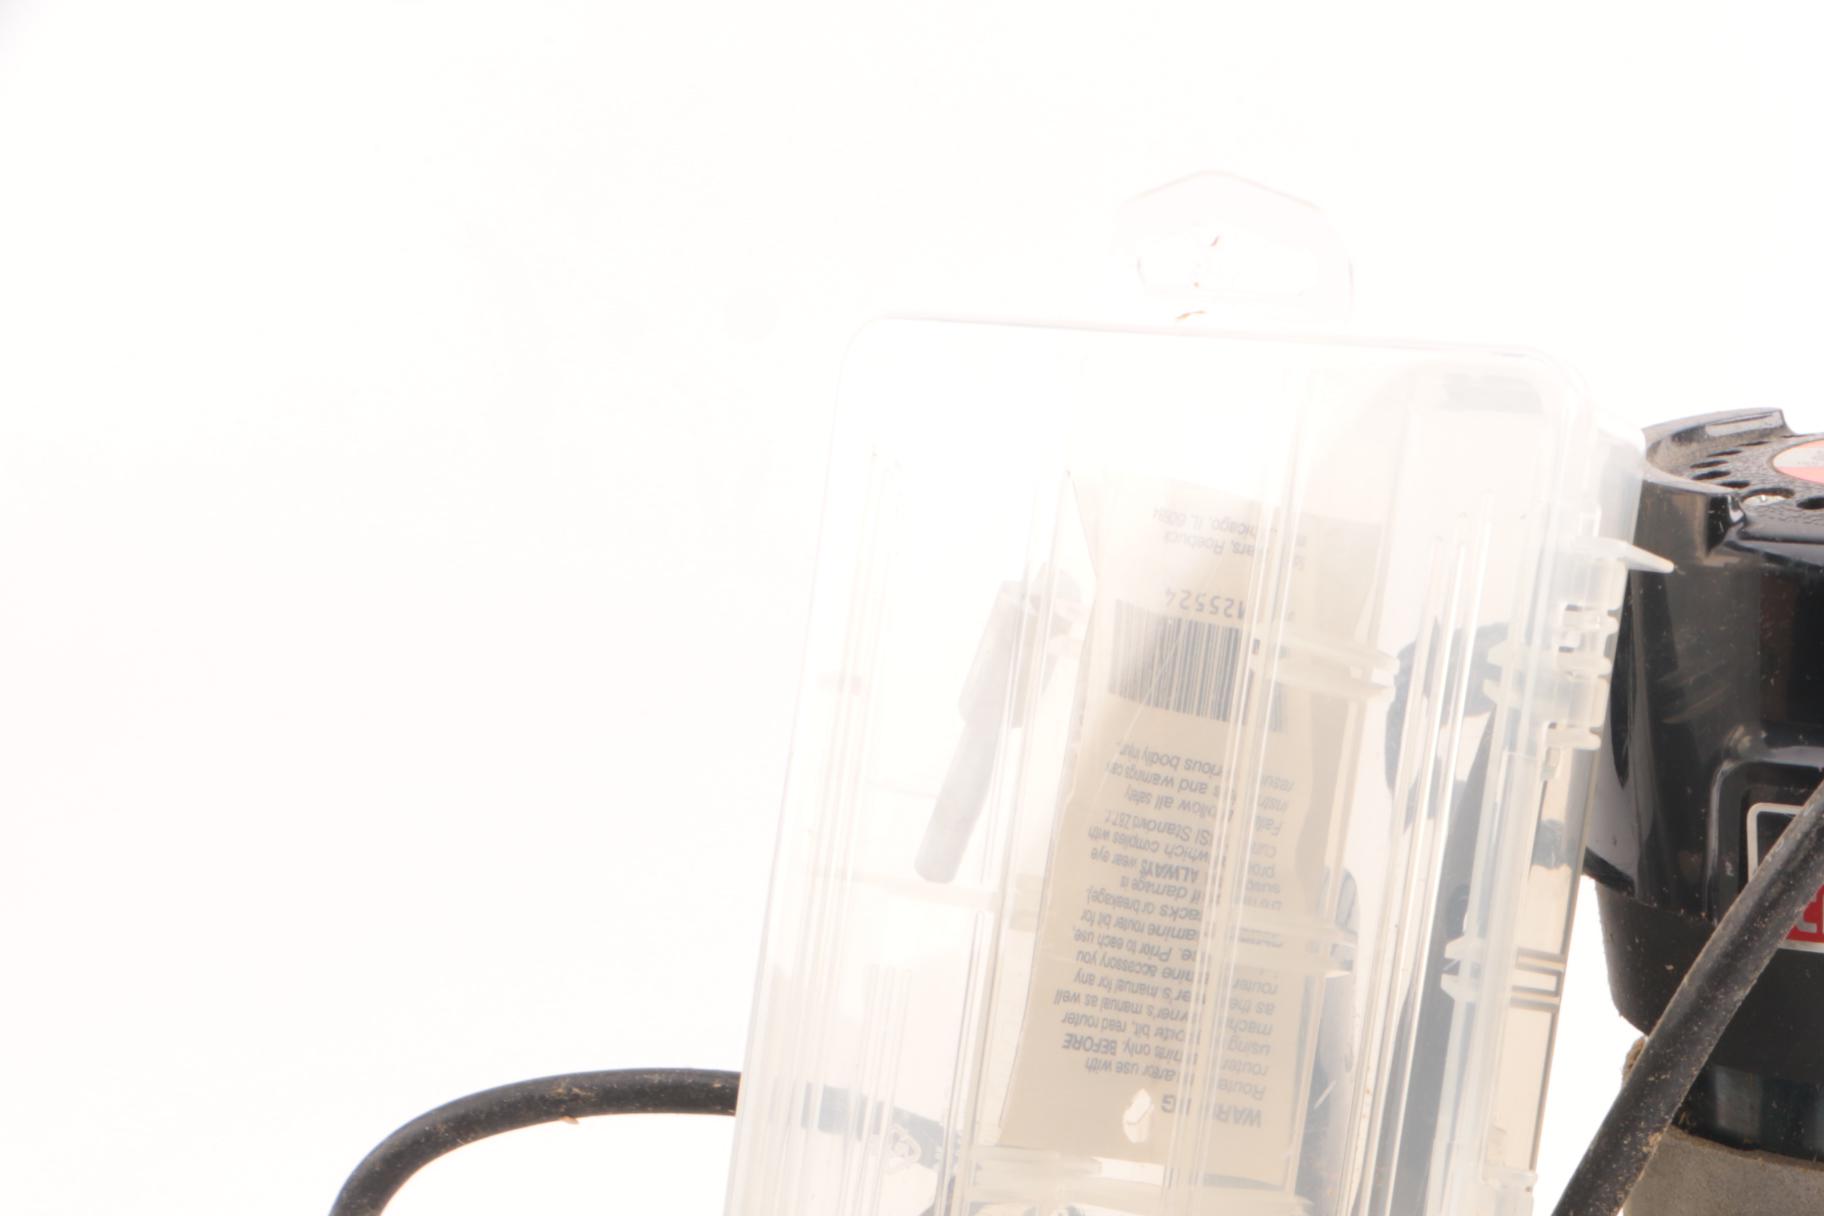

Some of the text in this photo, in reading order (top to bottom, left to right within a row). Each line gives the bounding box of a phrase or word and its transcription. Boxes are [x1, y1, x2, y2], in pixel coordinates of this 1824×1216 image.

[1176, 777, 1208, 796] and
[1154, 794, 1175, 811] all
[1089, 846, 1111, 864] eye
[1163, 843, 1210, 866] which
[1139, 859, 1200, 884] ALWAYS
[1131, 877, 1189, 904] damage
[1080, 909, 1097, 927] for
[1097, 912, 1112, 929] bit
[1114, 917, 1146, 934] router
[1097, 933, 1124, 950] each
[1076, 950, 1098, 967] you
[1139, 942, 1172, 963] Prior
[1073, 969, 1096, 986] any
[1097, 976, 1114, 992] for
[1116, 979, 1159, 998] manual
[1053, 989, 1081, 1006] well
[1084, 994, 1100, 1007] as
[1100, 997, 1143, 1015] manual
[1255, 1001, 1275, 1016] as
[1060, 1012, 1100, 1029] router
[1101, 1017, 1127, 1033] read
[1062, 1033, 1118, 1056] BEFORE
[1226, 1034, 1271, 1056] using
[1085, 1058, 1113, 1075] with
[1115, 1061, 1141, 1076] use
